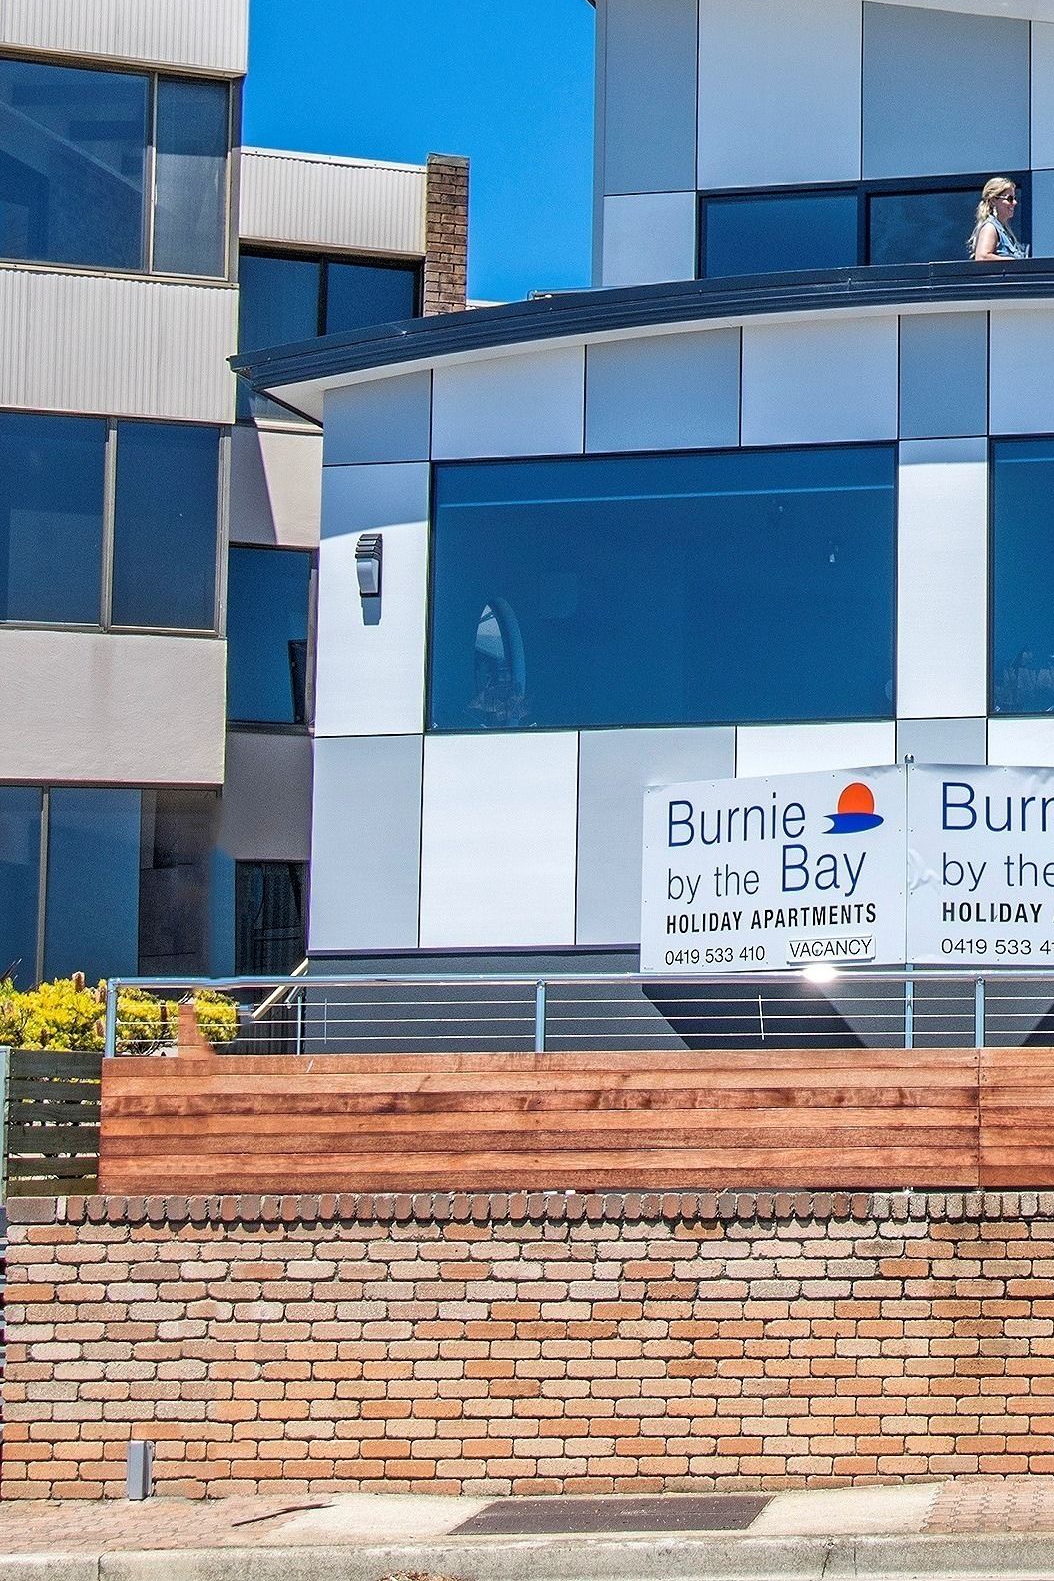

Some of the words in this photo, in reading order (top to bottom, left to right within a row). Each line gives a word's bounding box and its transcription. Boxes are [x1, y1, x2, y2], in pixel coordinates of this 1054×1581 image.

[668, 792, 806, 848] Burnie
[667, 867, 701, 905] by
[713, 864, 760, 898] the
[781, 843, 867, 898] Bay
[942, 851, 988, 892] by
[666, 911, 743, 934] HOLIDAY
[750, 902, 877, 930] APARTMENTS
[941, 901, 1043, 924] HOLIDAY
[665, 949, 700, 966] 0419
[705, 947, 734, 964] 533
[739, 945, 766, 962] 410
[789, 938, 873, 958] VACANCY
[941, 938, 988, 956] 0419
[994, 939, 1032, 956] 533
